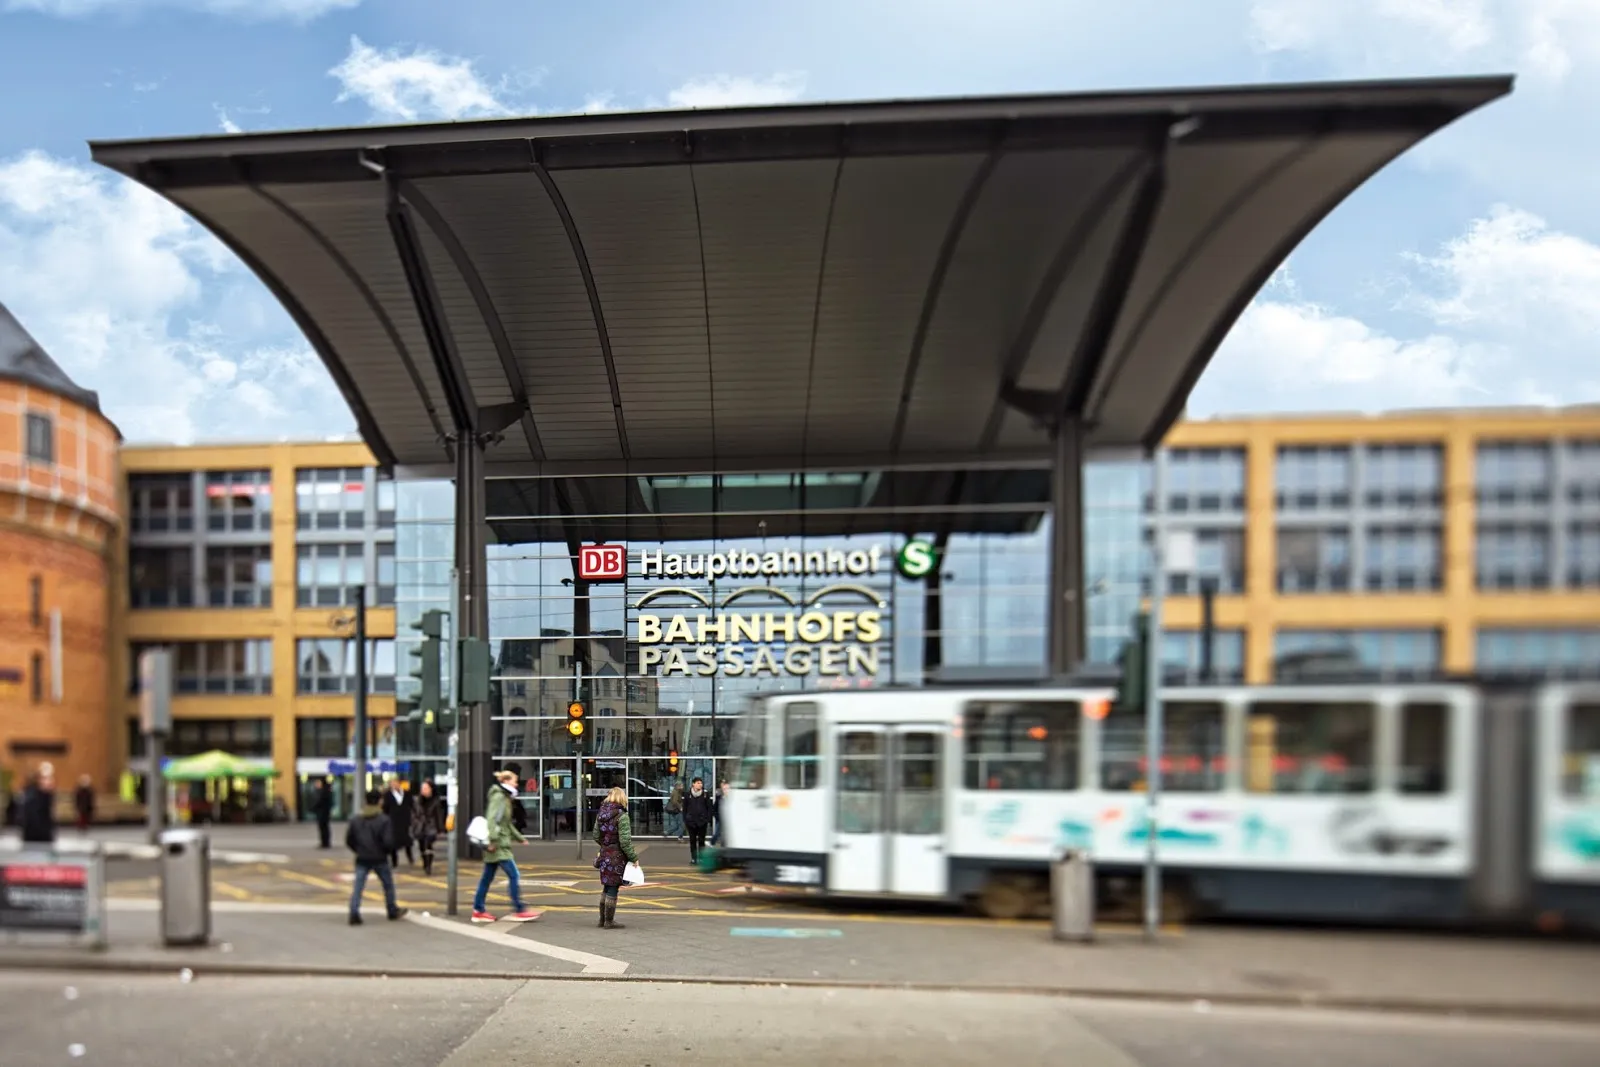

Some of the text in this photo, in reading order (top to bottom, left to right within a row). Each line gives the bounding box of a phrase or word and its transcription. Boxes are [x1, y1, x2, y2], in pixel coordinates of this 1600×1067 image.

[585, 551, 619, 573] DB
[641, 545, 882, 581] Hauptbahnhof
[902, 541, 932, 574] S
[638, 611, 882, 642] BAHNHOFS
[638, 646, 880, 676] PASSAGEN
